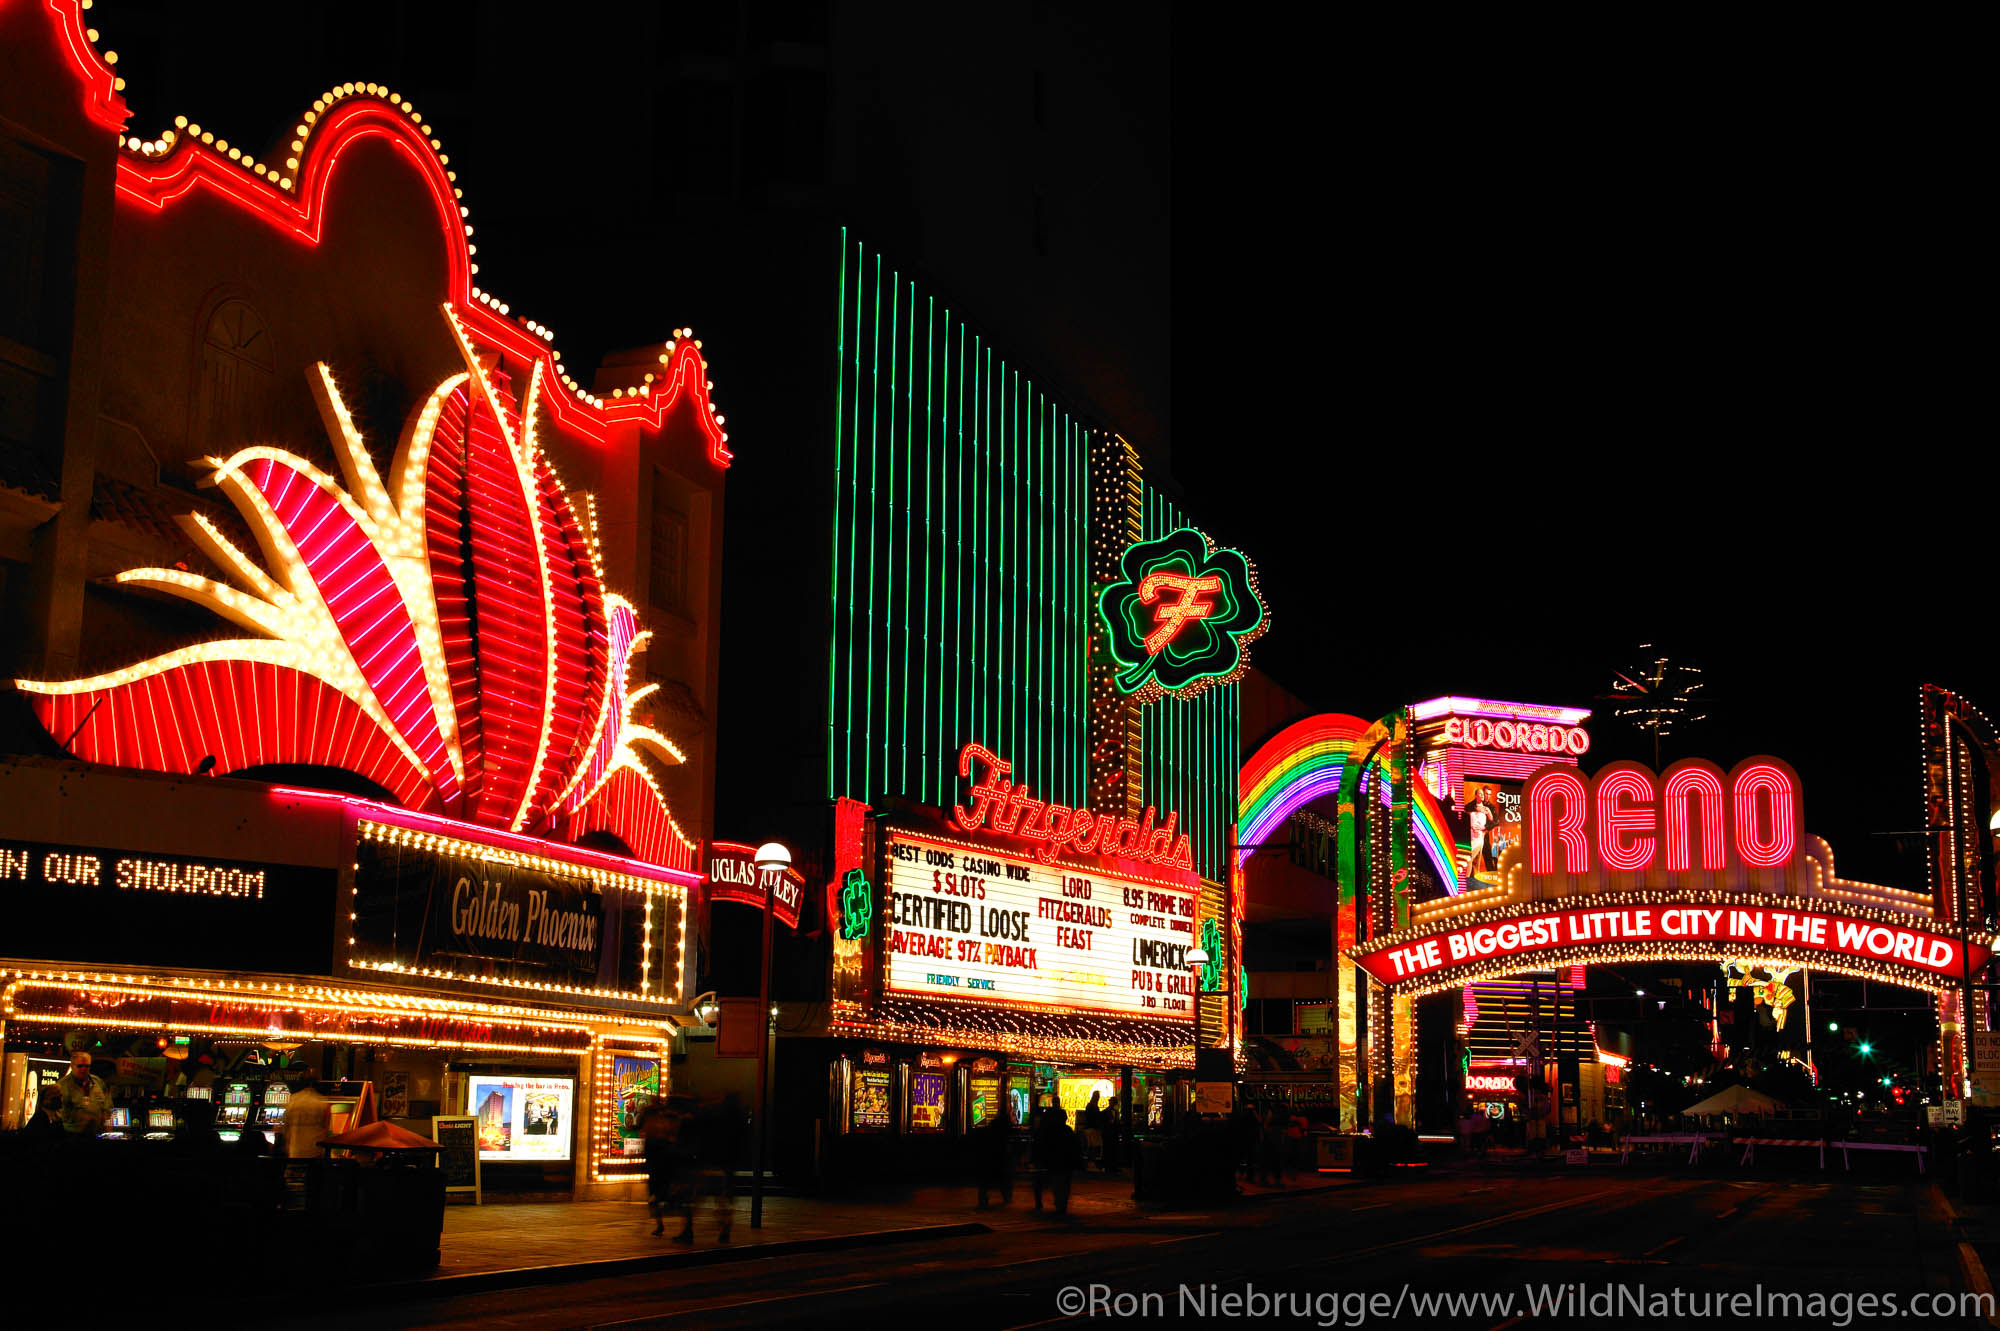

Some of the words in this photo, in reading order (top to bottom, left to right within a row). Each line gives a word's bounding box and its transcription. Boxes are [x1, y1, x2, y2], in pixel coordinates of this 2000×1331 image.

[1138, 571, 1222, 656] F
[1444, 716, 1590, 755] ELDORADO
[954, 743, 1193, 871] Fitzgeralds
[1504, 808, 1522, 823] Da
[1529, 764, 1796, 875] RENO
[44, 853, 101, 885] OUR
[116, 859, 264, 898] SHOWROOM
[711, 858, 755, 886] UGLAS
[893, 843, 921, 863] BEST
[926, 849, 954, 869] ODDS
[963, 856, 1001, 877] CASINO
[1006, 863, 1031, 882] WIDE
[945, 873, 986, 900] SLOTS
[1062, 875, 1092, 900] LORD
[1123, 886, 1144, 910] 8.95
[1147, 891, 1177, 915] PRIME
[1179, 897, 1194, 918] RIB
[452, 876, 520, 941] Golden
[523, 890, 595, 951] Phoenix
[892, 892, 972, 933] CERTIFIED
[980, 905, 1031, 942] LOOSE
[1038, 897, 1113, 929] FITZGERALDS
[1130, 913, 1166, 929] COMPLETE
[891, 929, 953, 960] AVERAGE
[957, 939, 982, 963] 97%
[984, 942, 1038, 970] PAYBACK
[1056, 926, 1093, 951] FEAST
[1388, 940, 1442, 976] THE
[1448, 917, 1561, 960] BIGGEST
[1569, 910, 1651, 940] LITTLE
[1661, 909, 1724, 935] CITY
[1729, 910, 1763, 938] IN
[1772, 913, 1828, 944] THE
[1835, 920, 1954, 968] WORLD
[926, 973, 960, 987] FRIENDLY
[967, 977, 996, 990] SERVICE
[1132, 969, 1153, 992] PUB
[1155, 973, 1163, 993] &
[1167, 974, 1194, 997] GRILL
[1142, 995, 1156, 1008] 3RD
[1163, 998, 1186, 1011] FLOOR
[1977, 1050, 2000, 1060] BLOC
